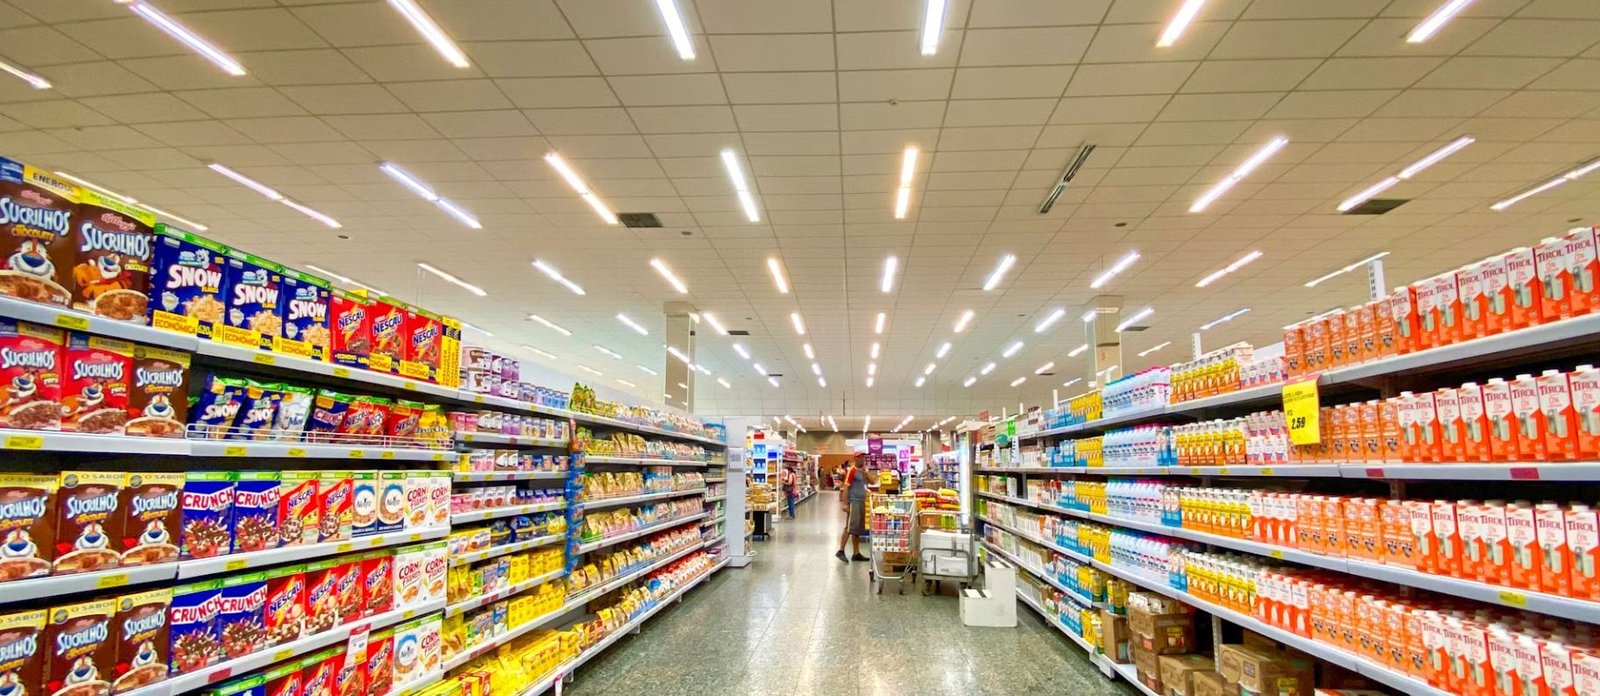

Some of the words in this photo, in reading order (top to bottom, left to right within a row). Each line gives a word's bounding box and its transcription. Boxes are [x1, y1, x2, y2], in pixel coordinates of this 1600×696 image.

[33, 172, 74, 194] ENERGIA
[0, 197, 71, 236] SUCRILHOS
[81, 222, 150, 261] SUCRILHOS
[1565, 240, 1593, 254] TIROL
[1508, 259, 1533, 271] TIROL
[1537, 249, 1564, 262] TIROL
[166, 264, 222, 289] SNOW
[1459, 275, 1480, 286] TIROL
[1482, 267, 1505, 279] TIROL
[233, 283, 279, 305] SNOW
[288, 300, 327, 320] SNOW
[338, 308, 365, 330] NESCAU
[373, 313, 402, 335] NESCAU
[413, 326, 438, 345] NESCAU
[1, 347, 55, 369] SUCRILHOS
[73, 360, 124, 380] SUCRILHOS
[136, 367, 183, 387] SUCRILHOS
[1512, 389, 1536, 399] TIROL
[1539, 385, 1567, 396] TIROL
[1572, 381, 1600, 391] TIROL
[1485, 393, 1509, 402] TIROL
[183, 488, 234, 509] CRUNCH
[236, 488, 280, 507] CRUNCH
[327, 485, 349, 506] NESCAU
[407, 487, 427, 501] CORN
[431, 486, 448, 500] CORN
[0, 497, 47, 519] UCRILHOS
[67, 492, 119, 519] SUCRILHOS
[132, 491, 178, 516] SUCRILHOS
[1480, 515, 1504, 525] TIROL
[1507, 517, 1532, 528] TIROL
[1538, 519, 1563, 530] TIROL
[1567, 521, 1596, 532] TIROL
[366, 562, 390, 586] NESCAU
[399, 562, 419, 579] CORN
[425, 557, 443, 574] CORN
[221, 587, 267, 612] CRUNCH
[270, 581, 302, 614] NESCAU
[310, 577, 336, 604] NESCAU
[172, 595, 221, 622] CRUNCH
[124, 607, 166, 641] SUCRILHOS
[57, 621, 108, 656] SUCRILHOS
[421, 631, 438, 648] CORN
[368, 643, 391, 671] NESCAU
[1514, 649, 1536, 662] TIROL
[1542, 656, 1567, 670] TIROL
[1574, 664, 1599, 679] TIROL
